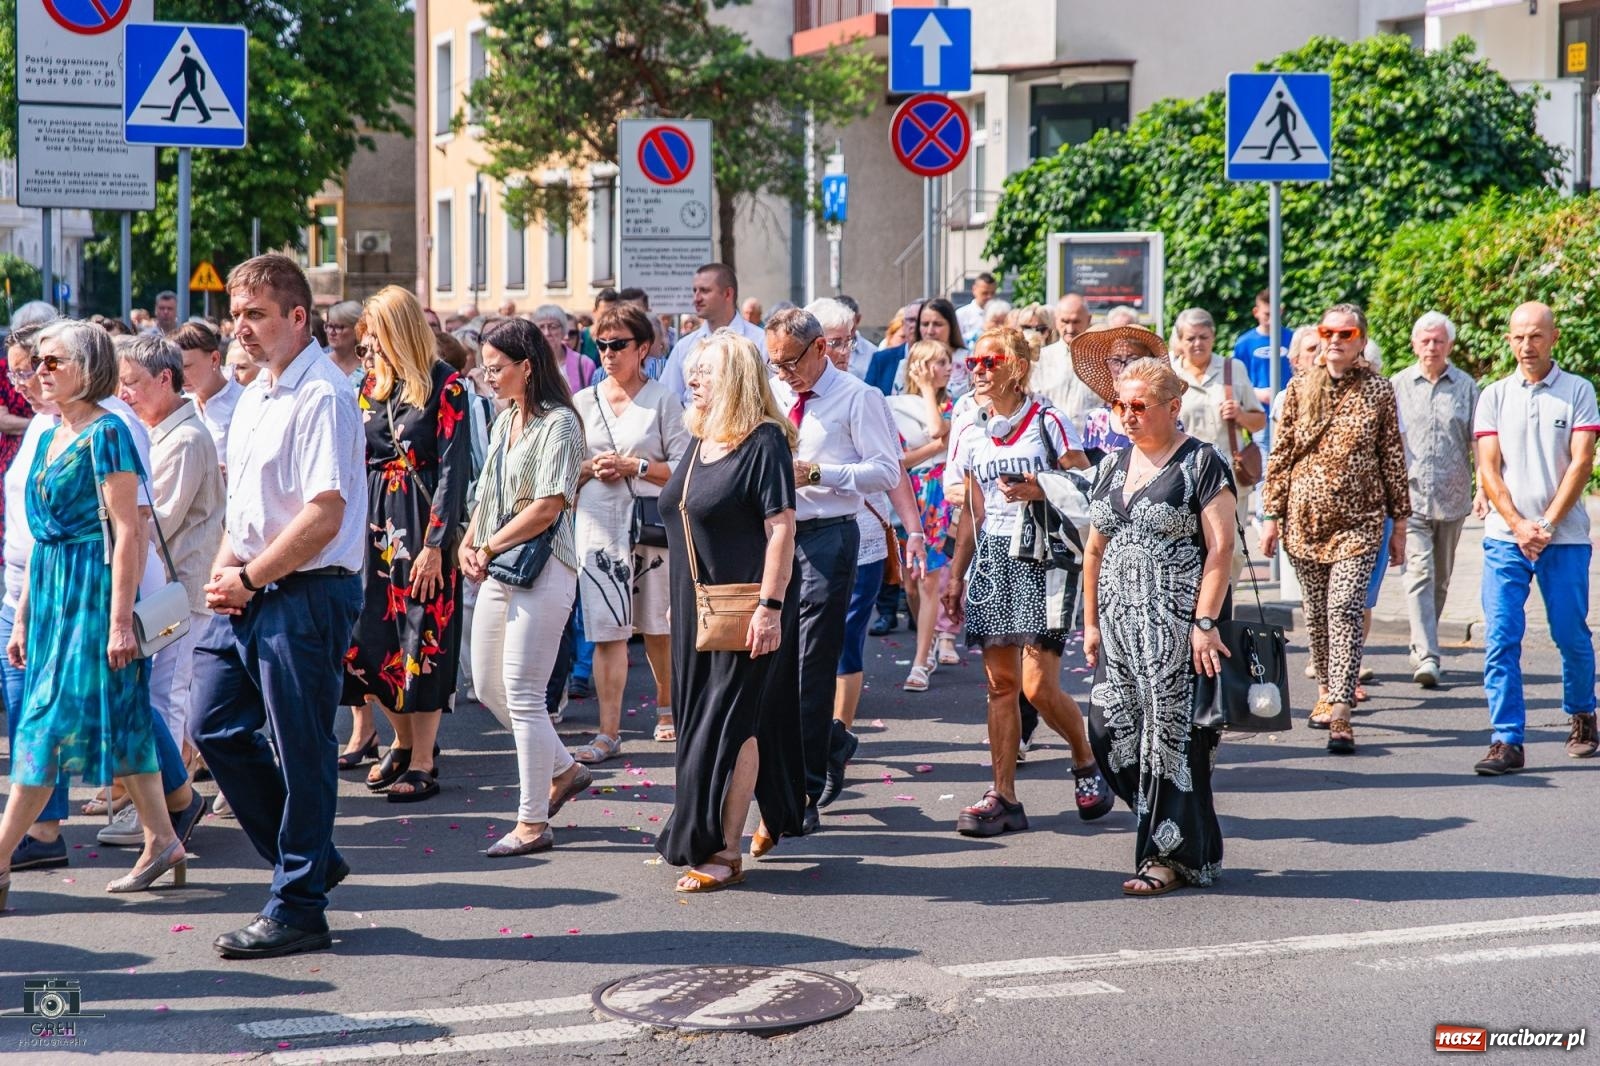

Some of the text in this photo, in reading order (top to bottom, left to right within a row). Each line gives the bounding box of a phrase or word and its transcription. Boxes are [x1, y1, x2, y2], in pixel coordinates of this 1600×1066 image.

[25, 54, 109, 68] Postój ograniczony
[25, 66, 37, 74] do
[94, 79, 116, 87] 17.00
[974, 456, 1045, 484] LORIDA
